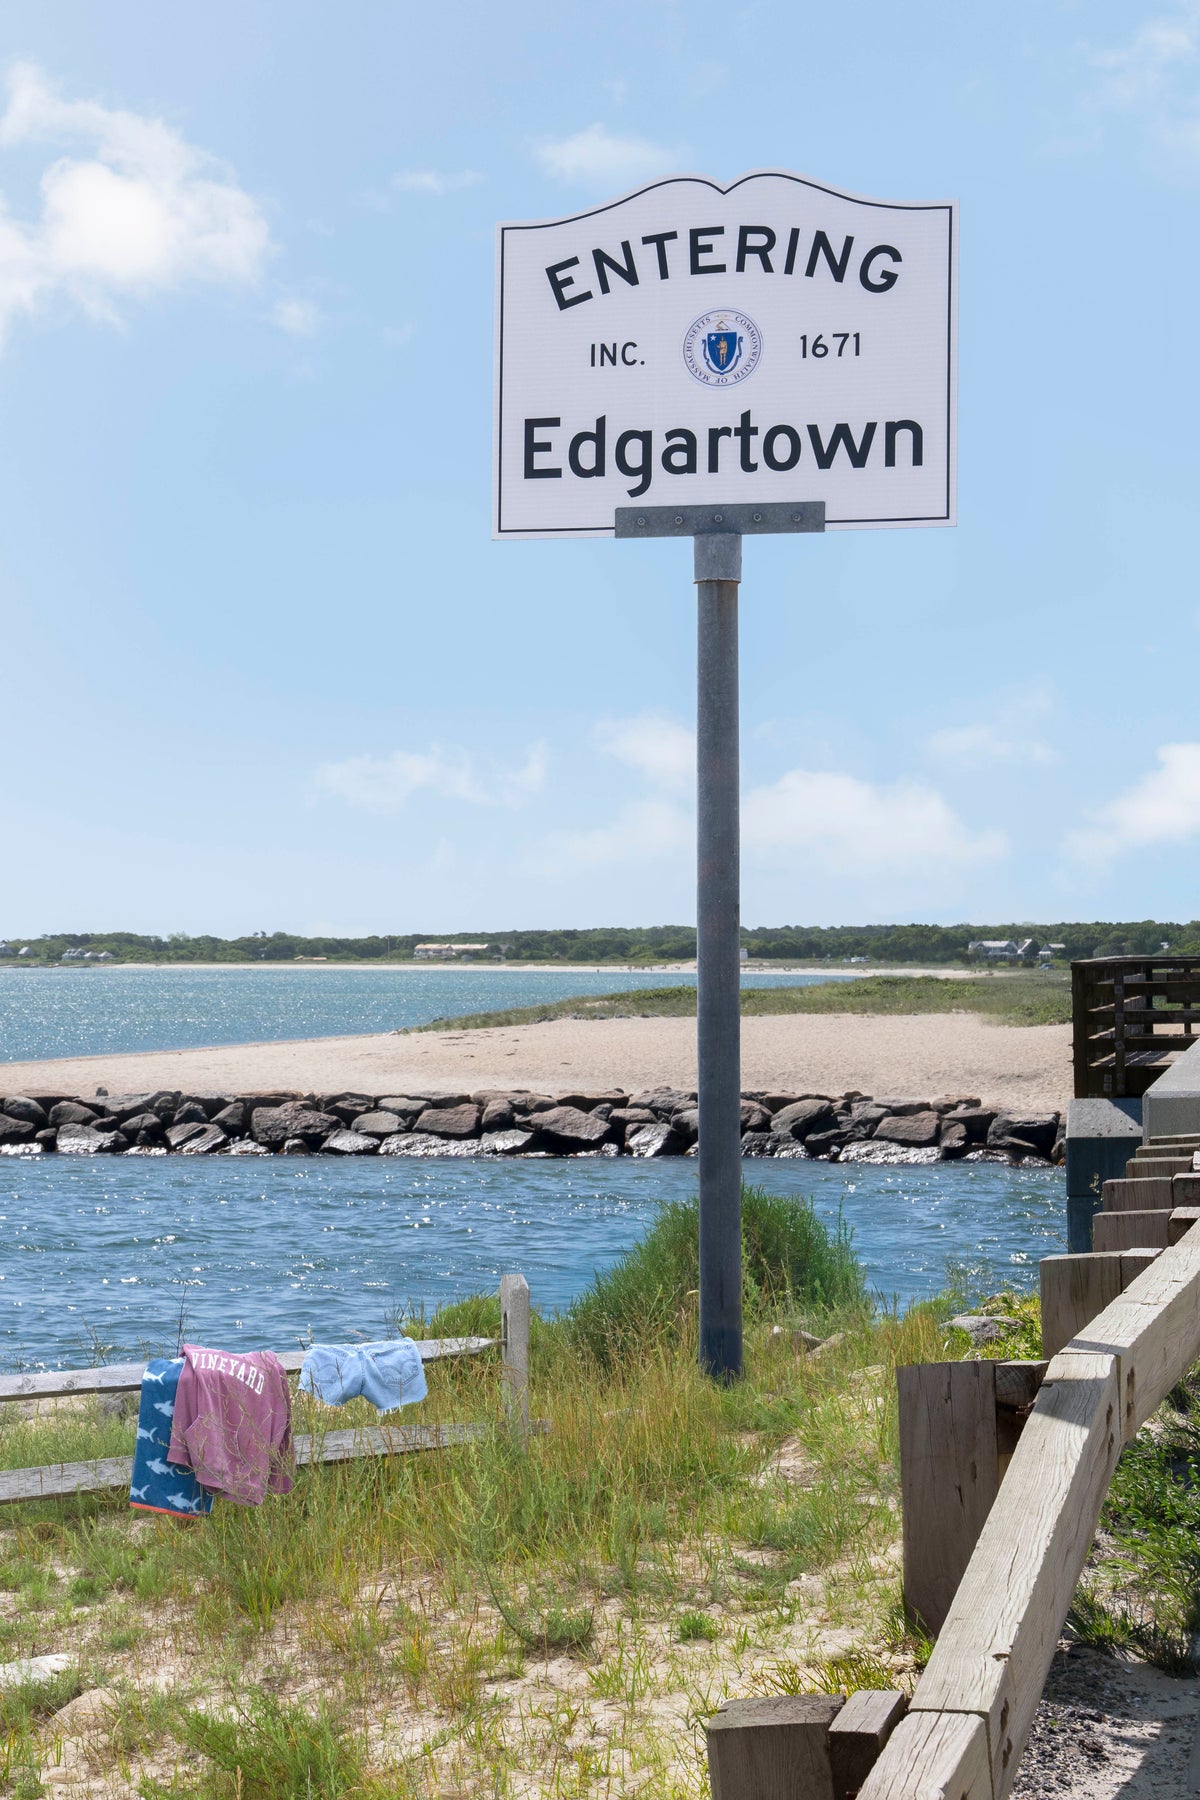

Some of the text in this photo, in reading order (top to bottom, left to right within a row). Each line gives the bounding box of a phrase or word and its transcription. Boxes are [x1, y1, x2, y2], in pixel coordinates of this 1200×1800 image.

[545, 225, 903, 311] ENTERING
[590, 332, 861, 368] INC. 1671
[686, 316, 710, 381] MASSACHUSETTS
[733, 316, 758, 380] COMMONWEALTH
[523, 409, 924, 498] Edgartown
[191, 1352, 264, 1395] VINEYARD
